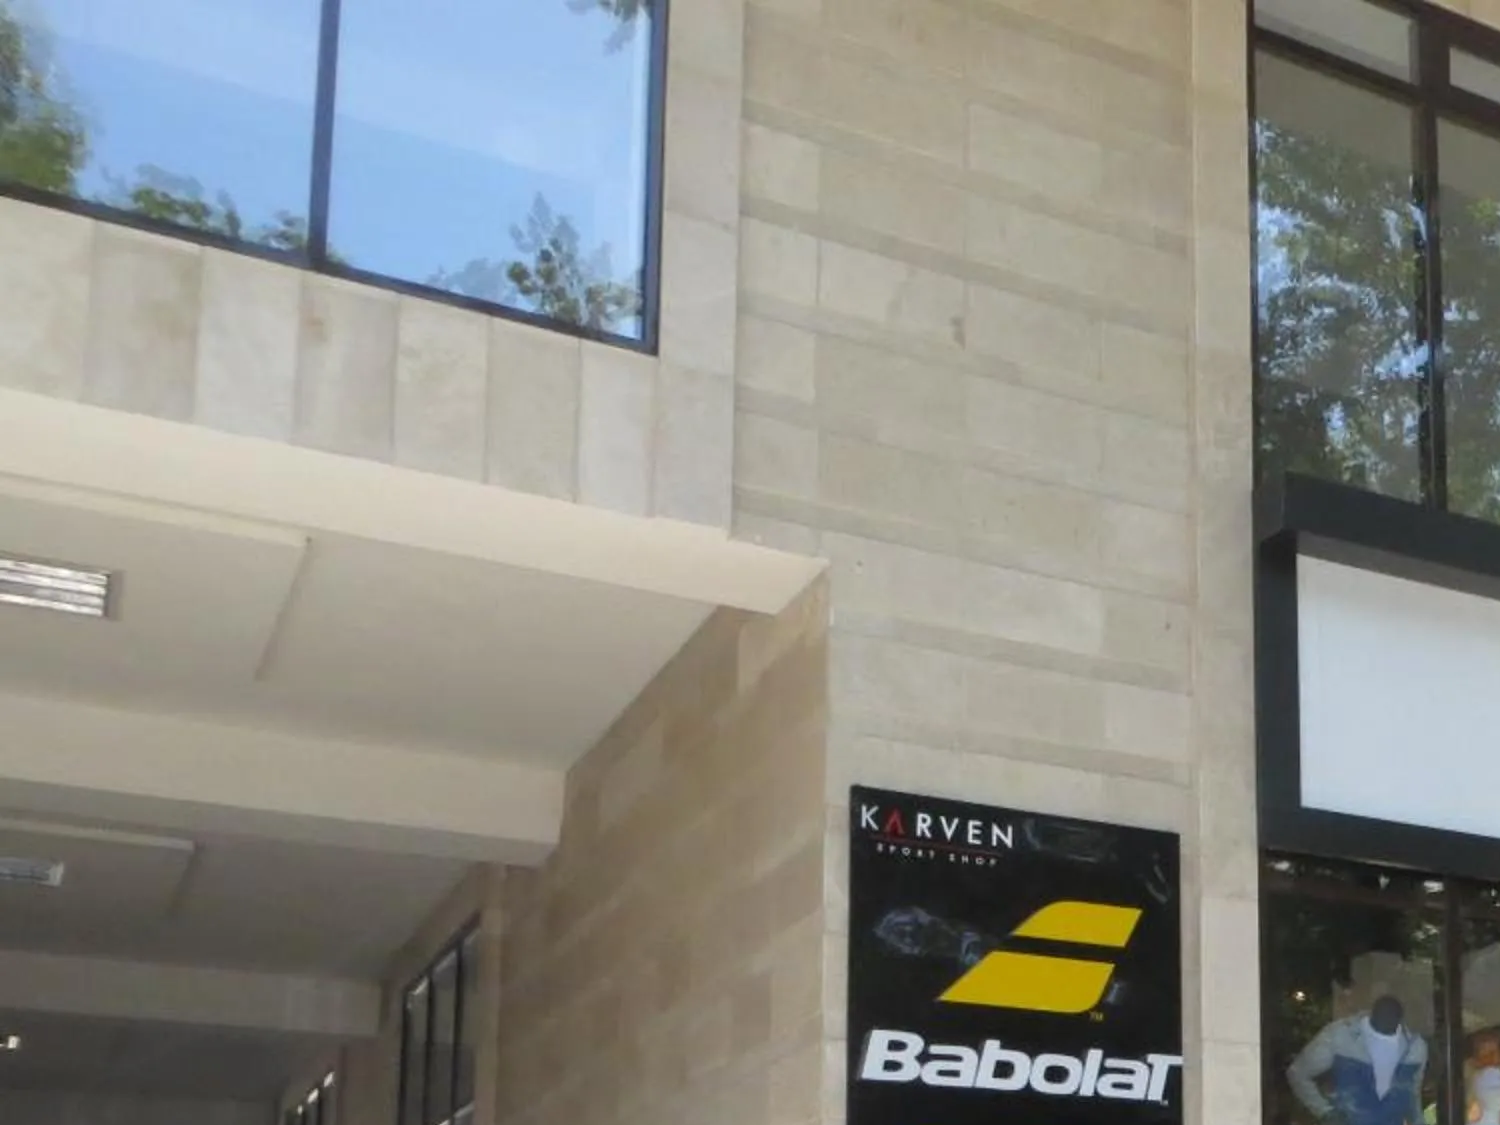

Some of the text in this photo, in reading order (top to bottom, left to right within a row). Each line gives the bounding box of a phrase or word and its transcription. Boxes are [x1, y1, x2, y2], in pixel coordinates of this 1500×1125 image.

[860, 804, 1014, 849] KARVEN
[876, 842, 997, 868] SPORT SHOP
